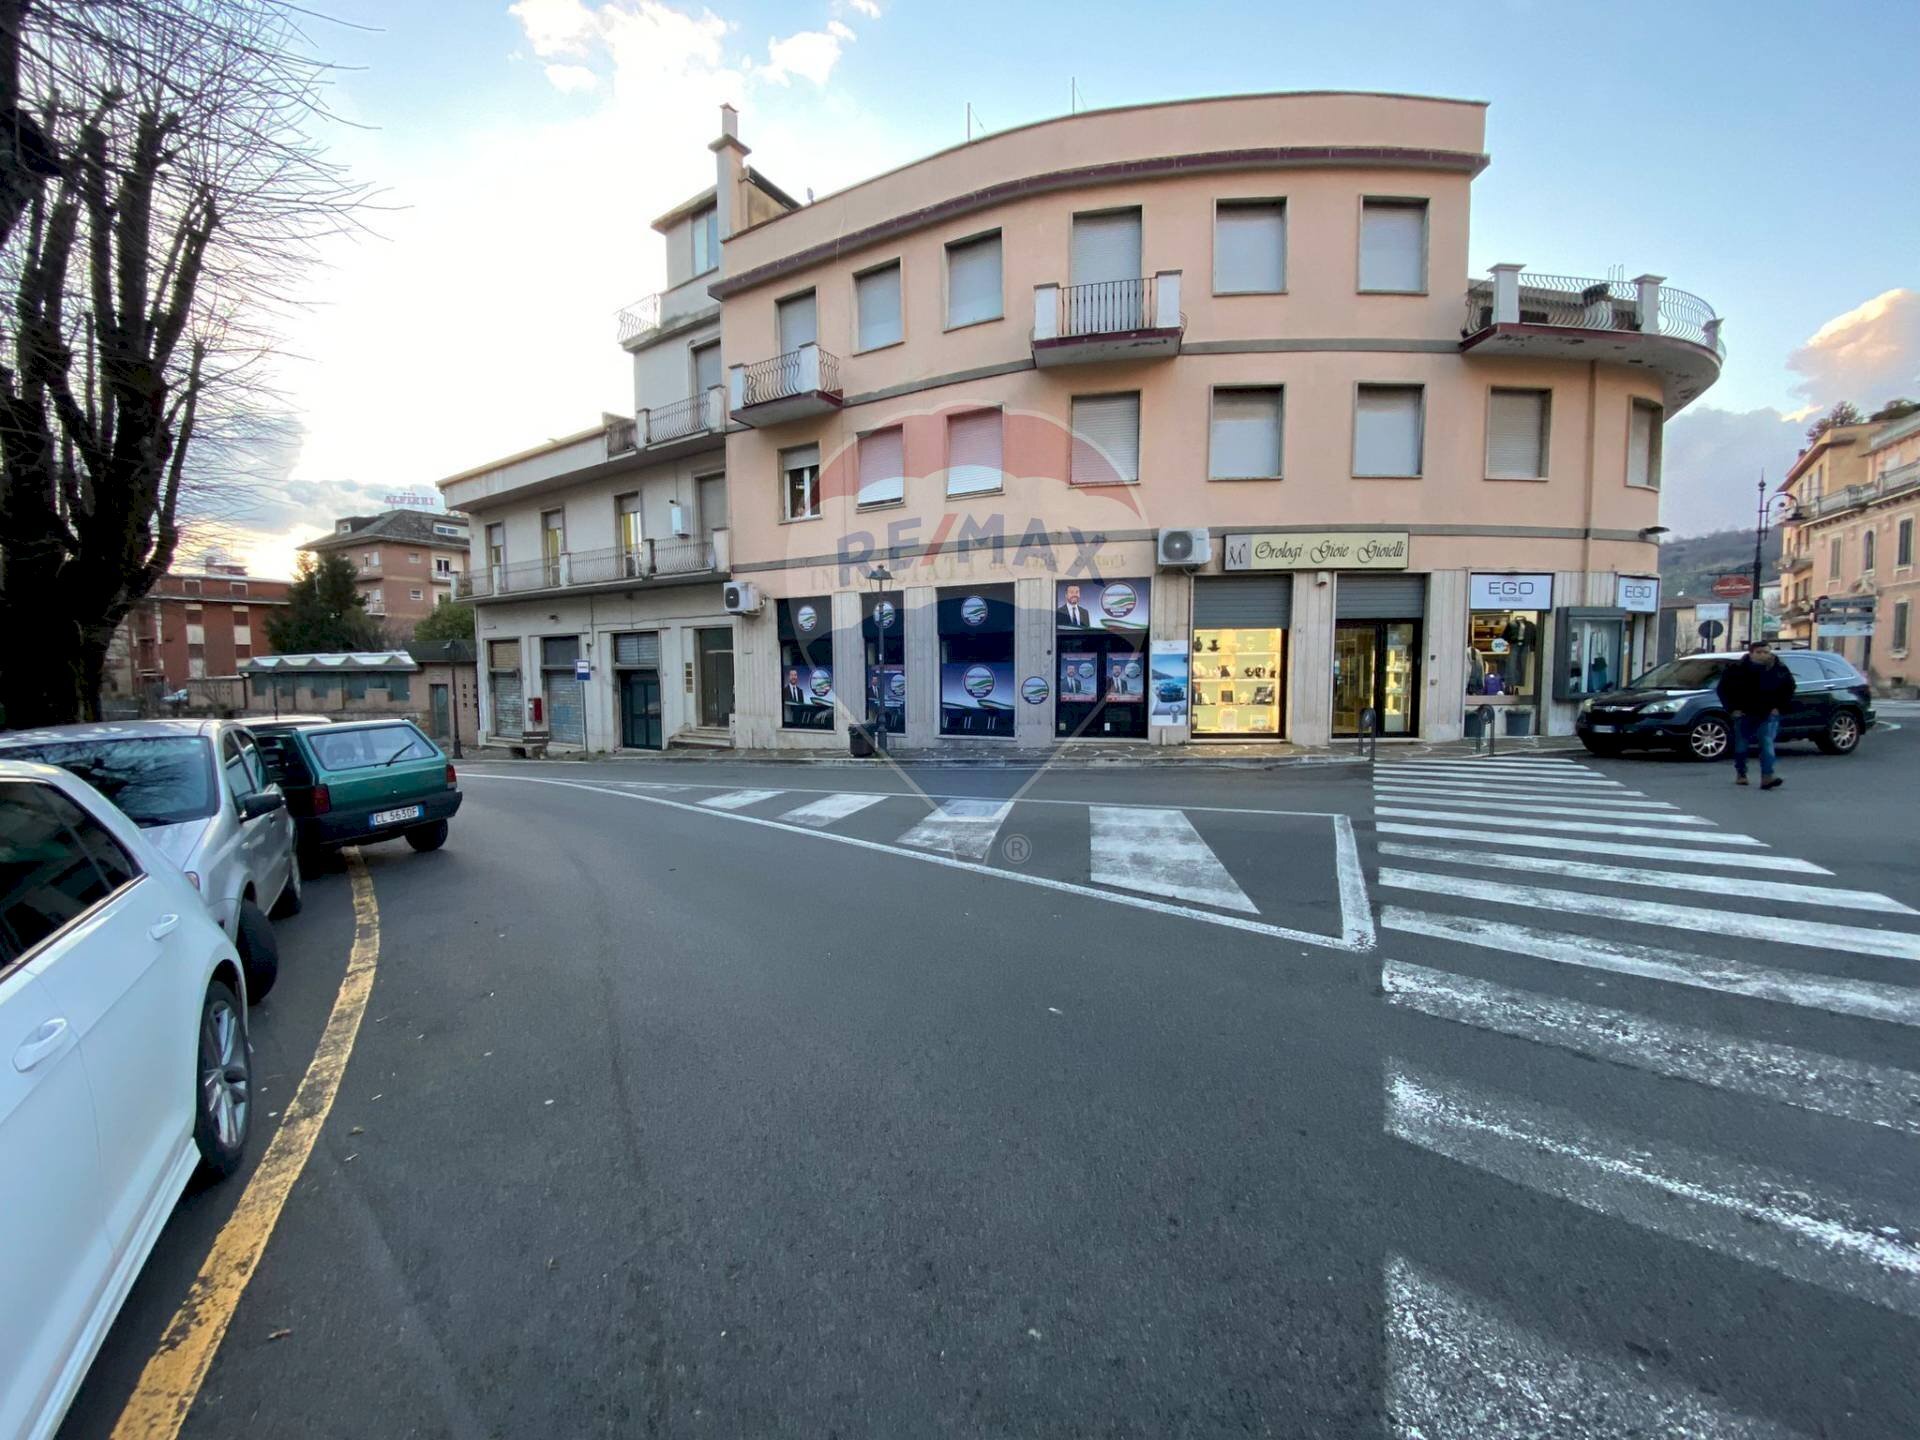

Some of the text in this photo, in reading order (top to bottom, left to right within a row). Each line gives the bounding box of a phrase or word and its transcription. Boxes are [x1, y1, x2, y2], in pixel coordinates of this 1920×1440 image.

[1255, 540, 1406, 565] Orologi Gioie Gioielli
[1488, 581, 1534, 595] EGO
[1625, 585, 1652, 599] EGO
